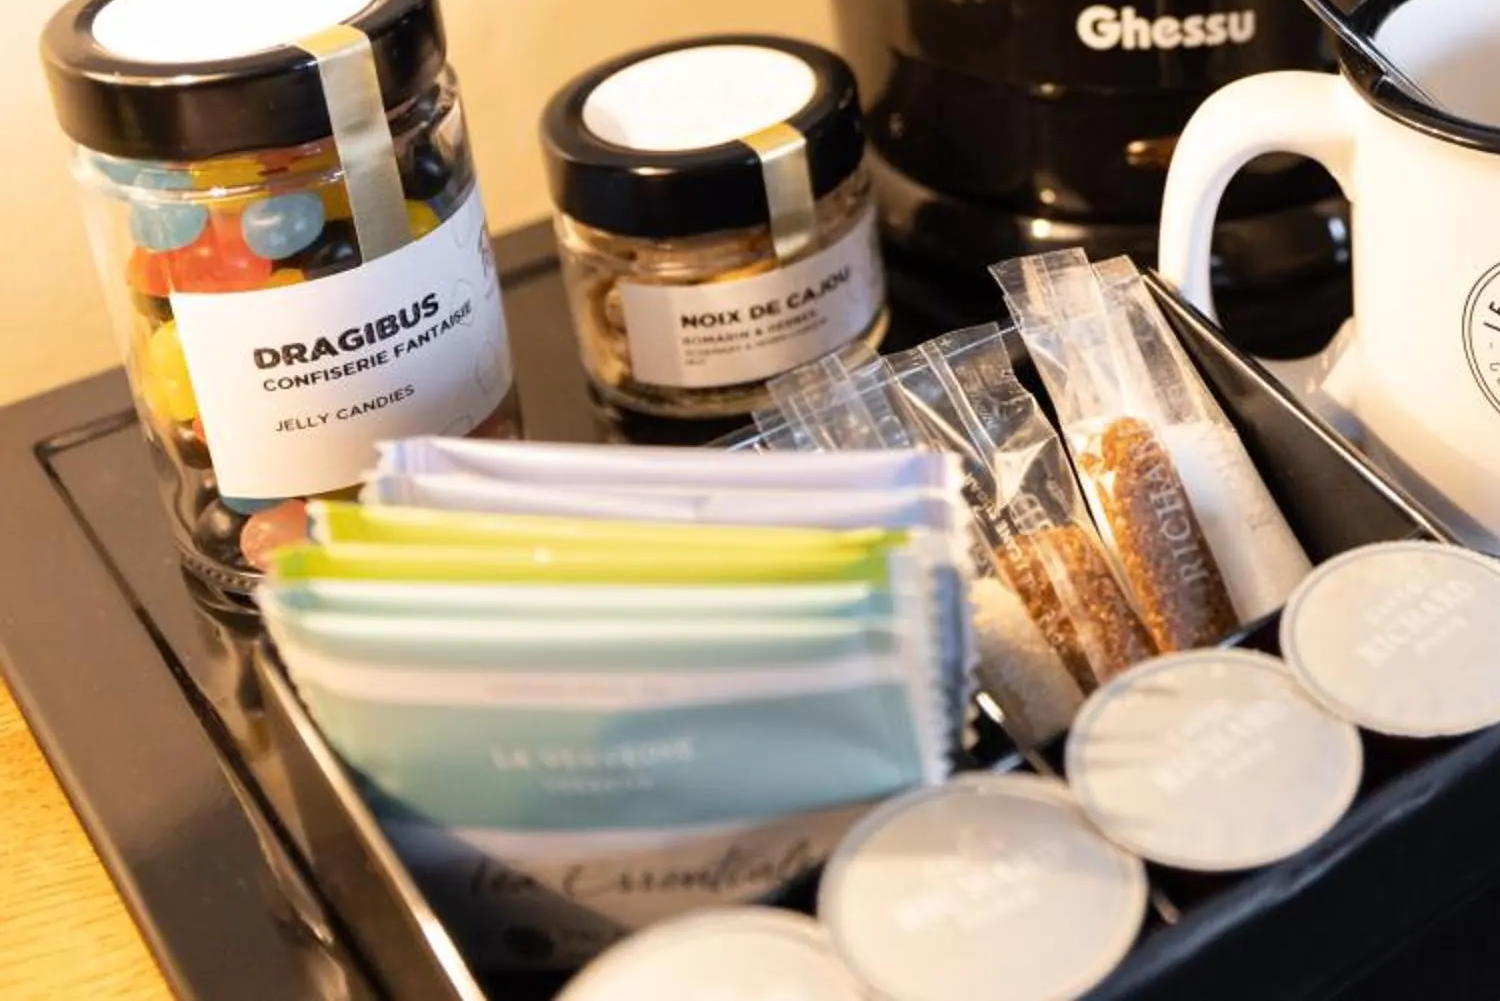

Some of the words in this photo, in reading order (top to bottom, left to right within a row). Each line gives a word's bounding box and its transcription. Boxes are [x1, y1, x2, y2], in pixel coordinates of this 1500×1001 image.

[1076, 4, 1256, 50] Ghessu
[680, 308, 741, 329] NOIX
[750, 300, 781, 320] DE
[787, 265, 851, 310] CAJOU
[253, 292, 440, 370] DRAGIBUS
[263, 350, 389, 392] CONFISERIE
[393, 299, 473, 359] FANTAISIE
[275, 412, 330, 433] JELLY
[336, 384, 416, 421] CANDIES
